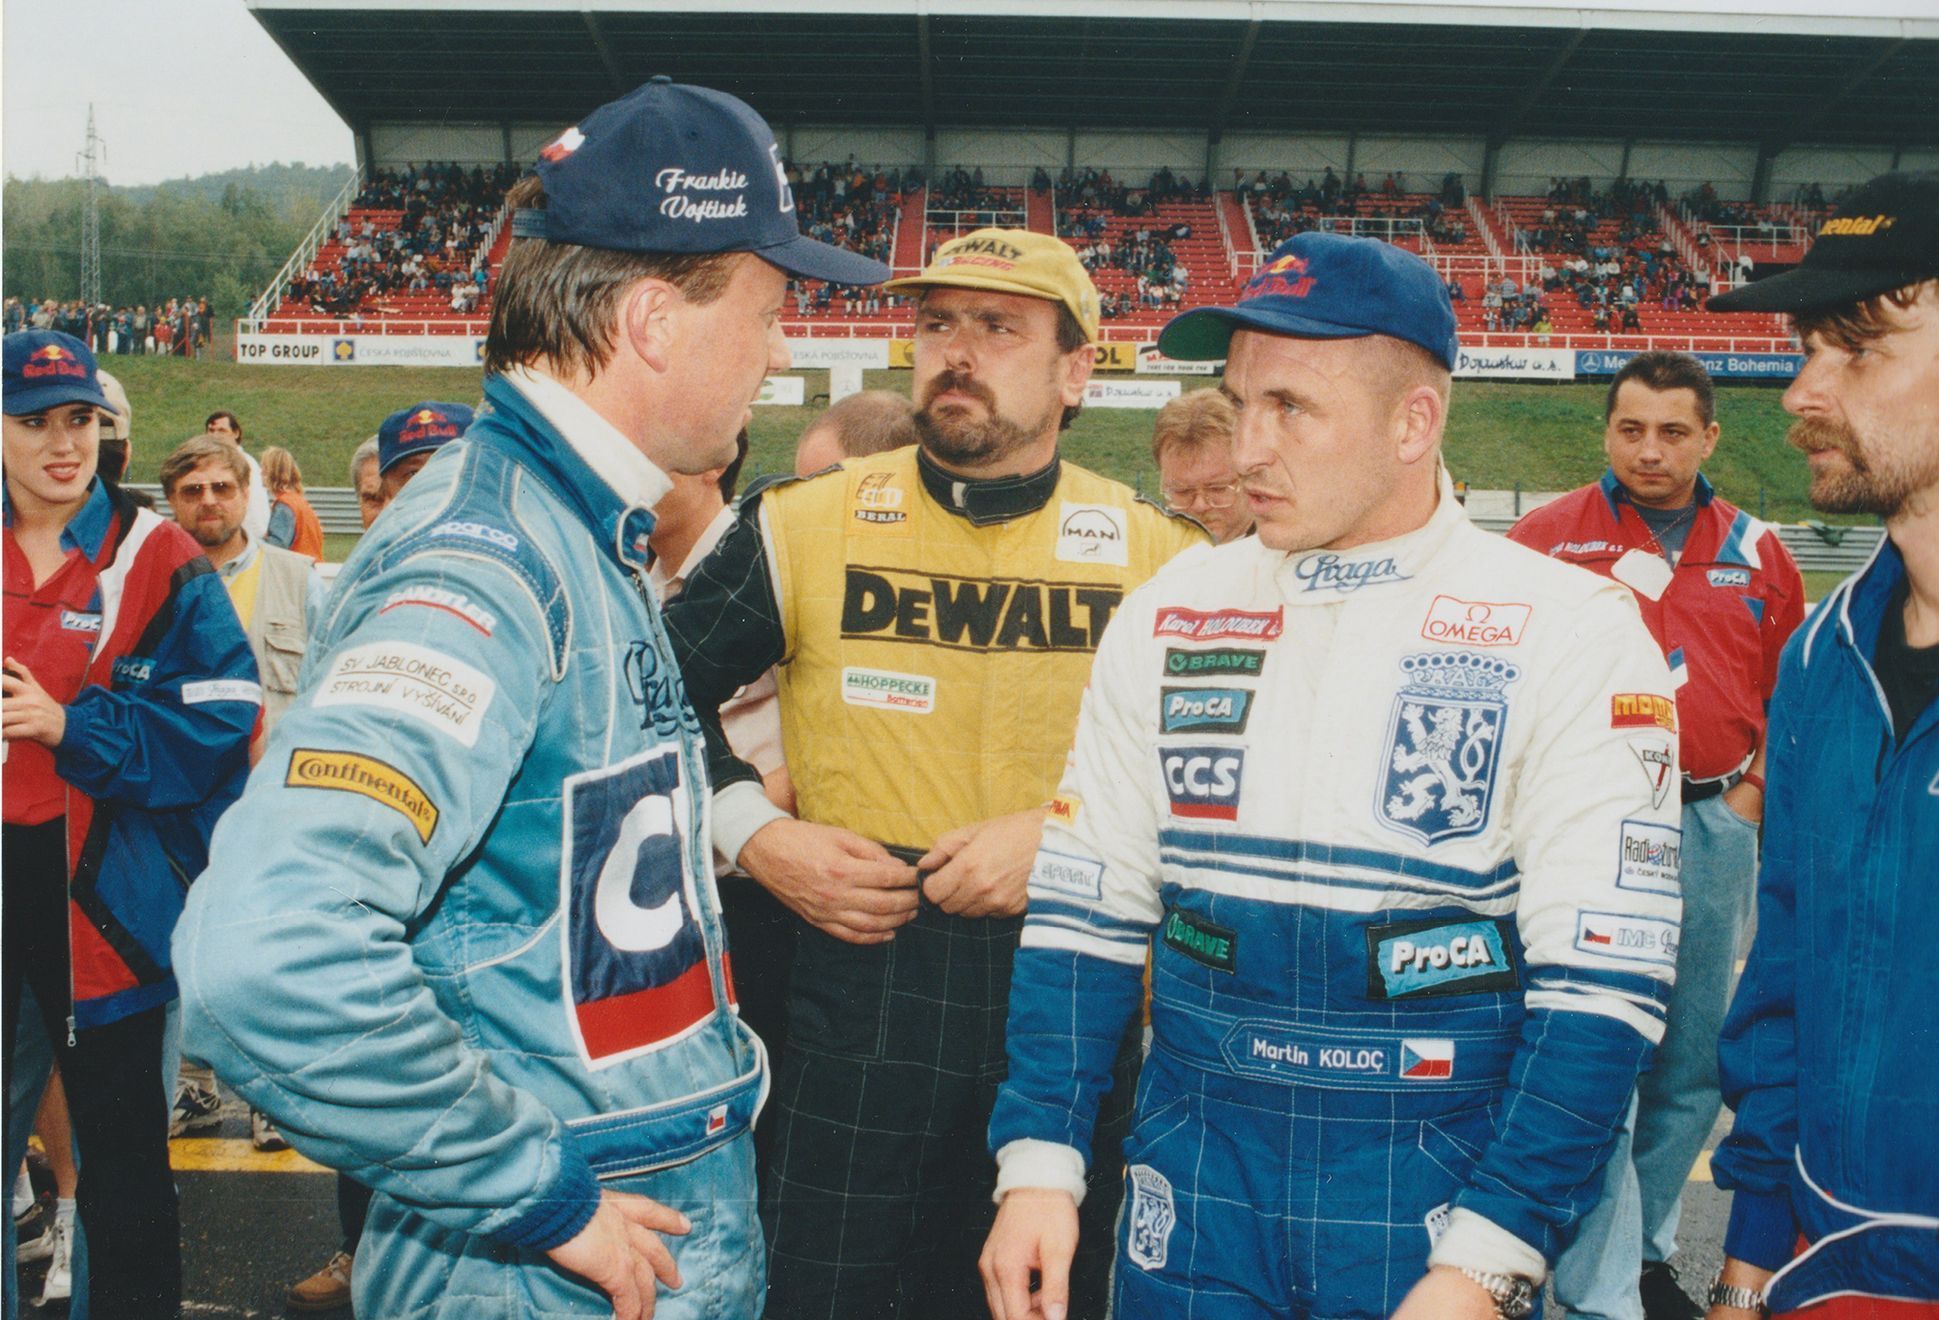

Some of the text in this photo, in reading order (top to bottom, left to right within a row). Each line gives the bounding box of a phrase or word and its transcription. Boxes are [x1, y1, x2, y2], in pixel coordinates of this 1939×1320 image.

[655, 168, 749, 194] Frankie
[241, 344, 320, 359] TOP GROUP
[1728, 358, 1793, 372] Bohemia
[1066, 527, 1116, 541] MAN
[1294, 554, 1414, 594] Praga
[1709, 570, 1748, 585] ProCA
[65, 613, 102, 632] ProC
[1429, 620, 1513, 642] OMEGA
[366, 656, 452, 687] JABLONEC
[1189, 653, 1260, 670] BRAVE
[330, 678, 399, 695] STROJNÍ
[861, 677, 930, 695] HOPPECKE
[1168, 695, 1233, 717] ProCA
[1164, 756, 1240, 797] CCS
[298, 758, 425, 818] Continental
[1390, 934, 1491, 973] ProCA
[1252, 1037, 1309, 1067] Martin
